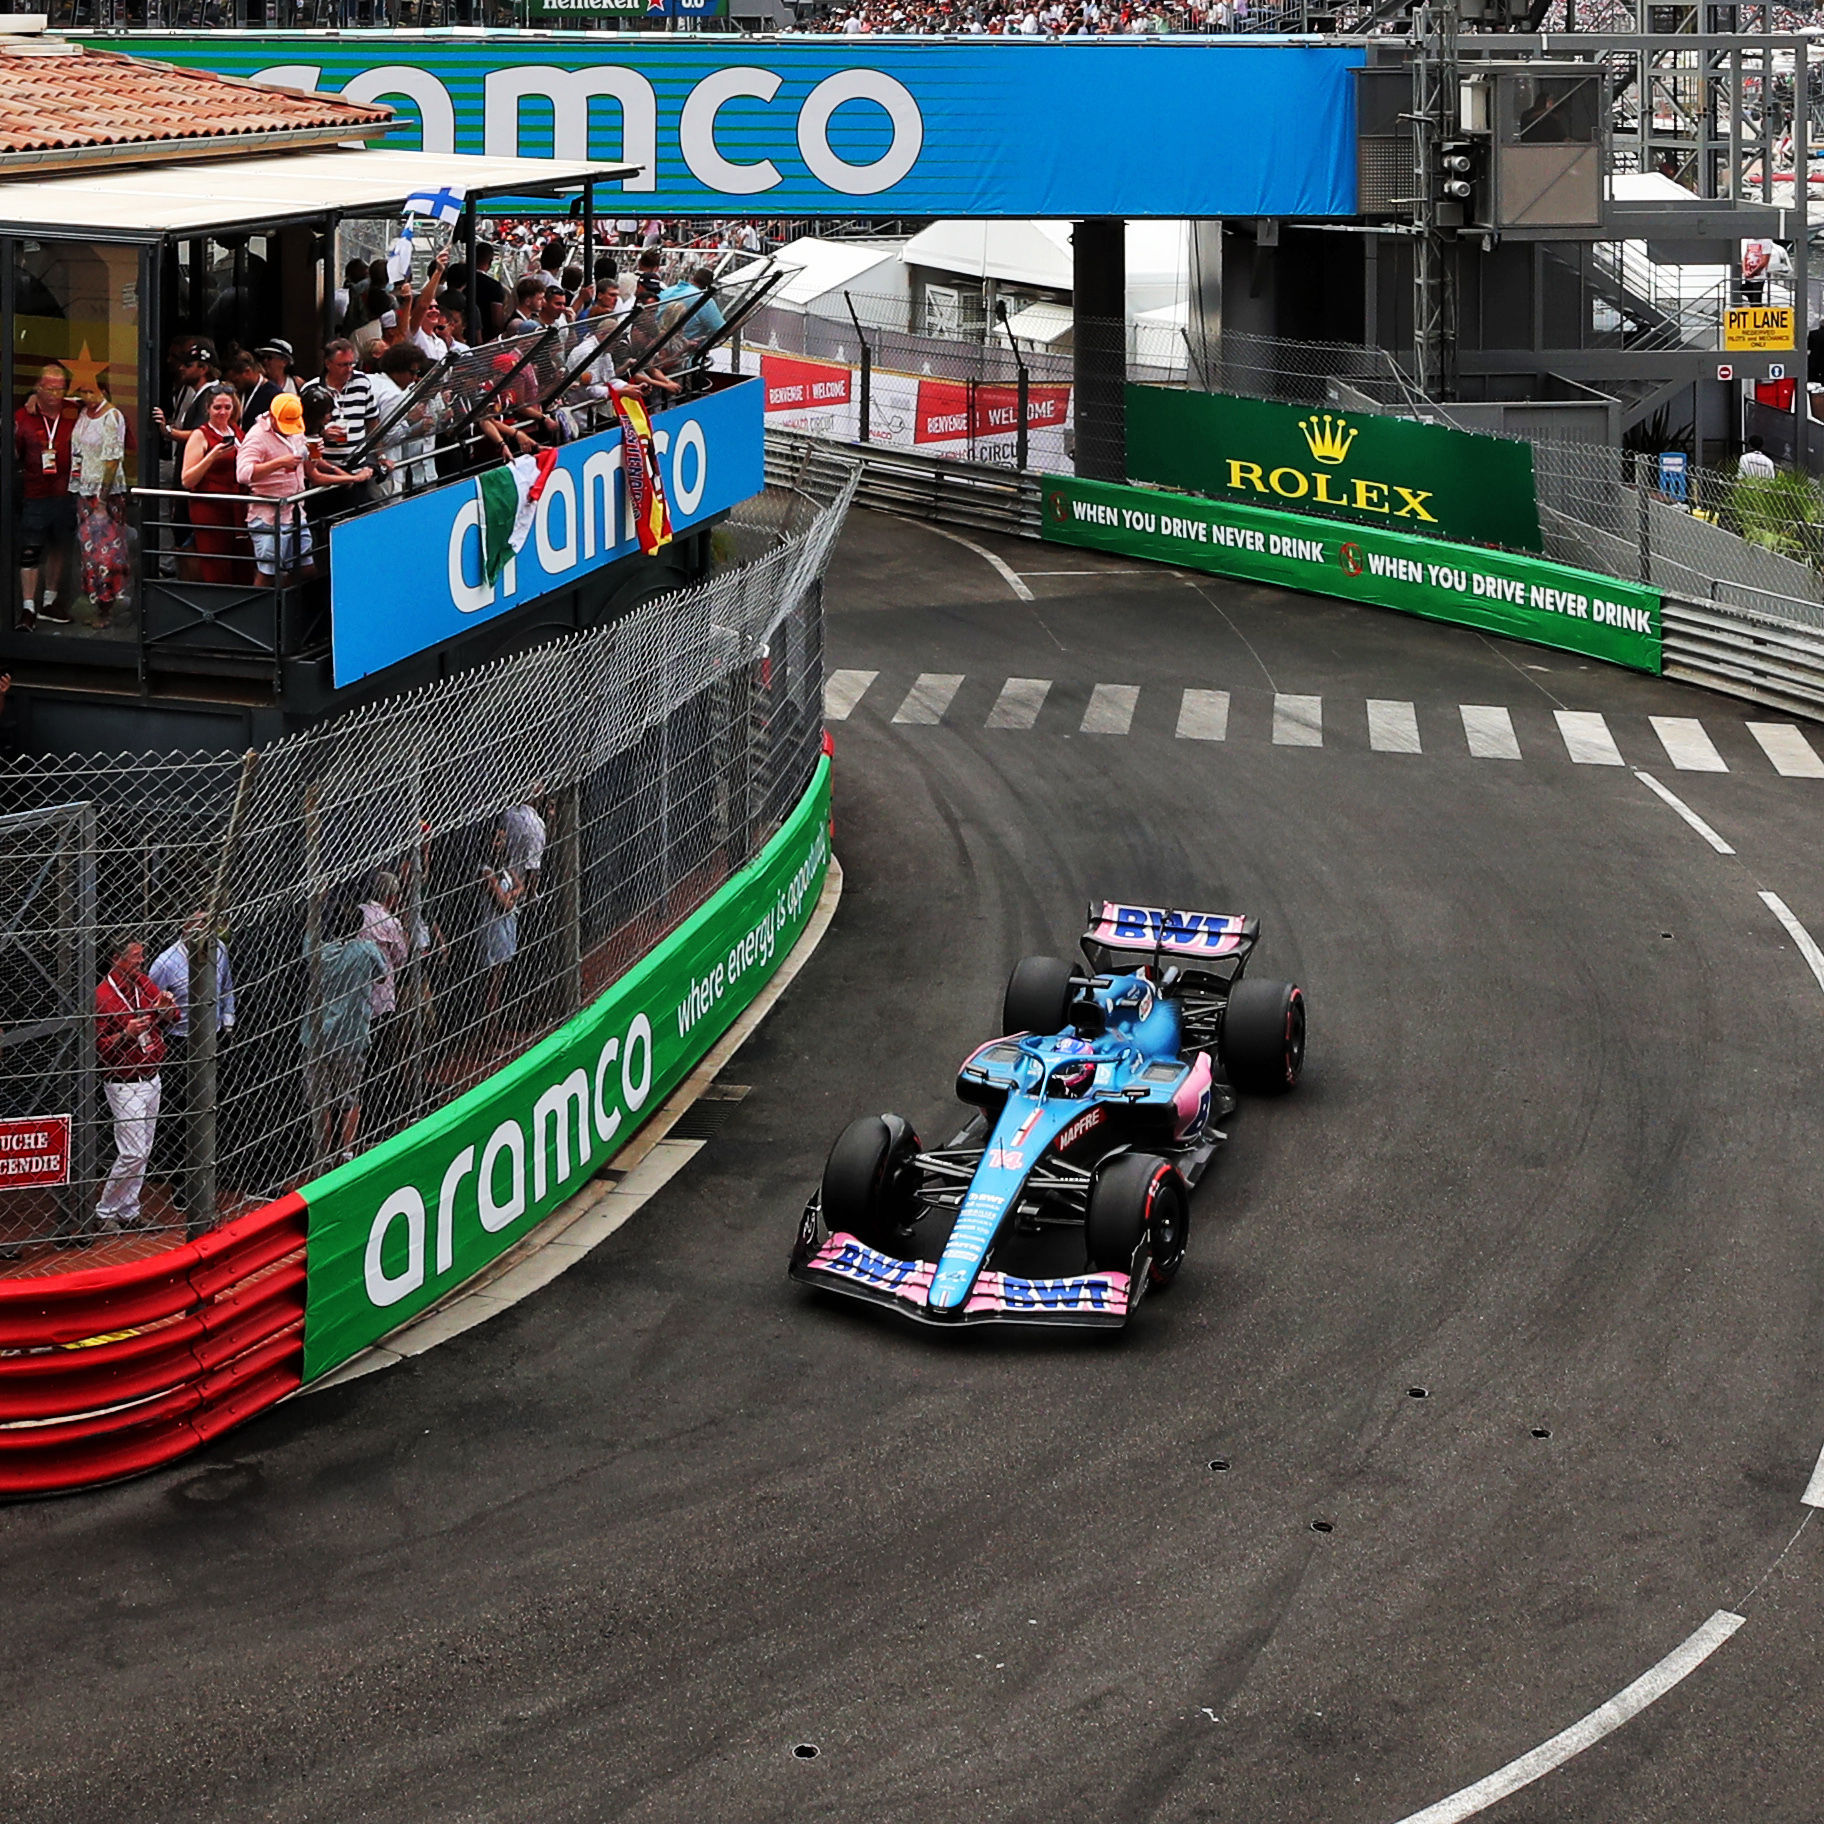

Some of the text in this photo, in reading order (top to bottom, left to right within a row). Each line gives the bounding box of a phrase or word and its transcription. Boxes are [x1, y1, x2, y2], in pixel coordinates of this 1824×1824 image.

[1729, 311, 1788, 329] PIT LANE
[812, 380, 846, 400] WELCOME
[988, 400, 1056, 427] WELOME
[980, 440, 1030, 462] CIRCU
[1226, 459, 1438, 523] ROLEX
[1072, 500, 1325, 563] WHEN YOU DRIVE NEVER DRINK
[1368, 553, 1652, 634] WHEN YOU DRIVE NEVER DRINK
[1115, 907, 1229, 948] BWT
[364, 1012, 652, 1308] aramco
[677, 961, 724, 1038] where
[727, 907, 776, 985] energy
[776, 888, 786, 931] is
[1059, 1108, 1101, 1152] MAPFRE
[988, 1149, 1025, 1171] 14
[830, 1242, 918, 1290] BWT
[1004, 1279, 1109, 1308] BWT
